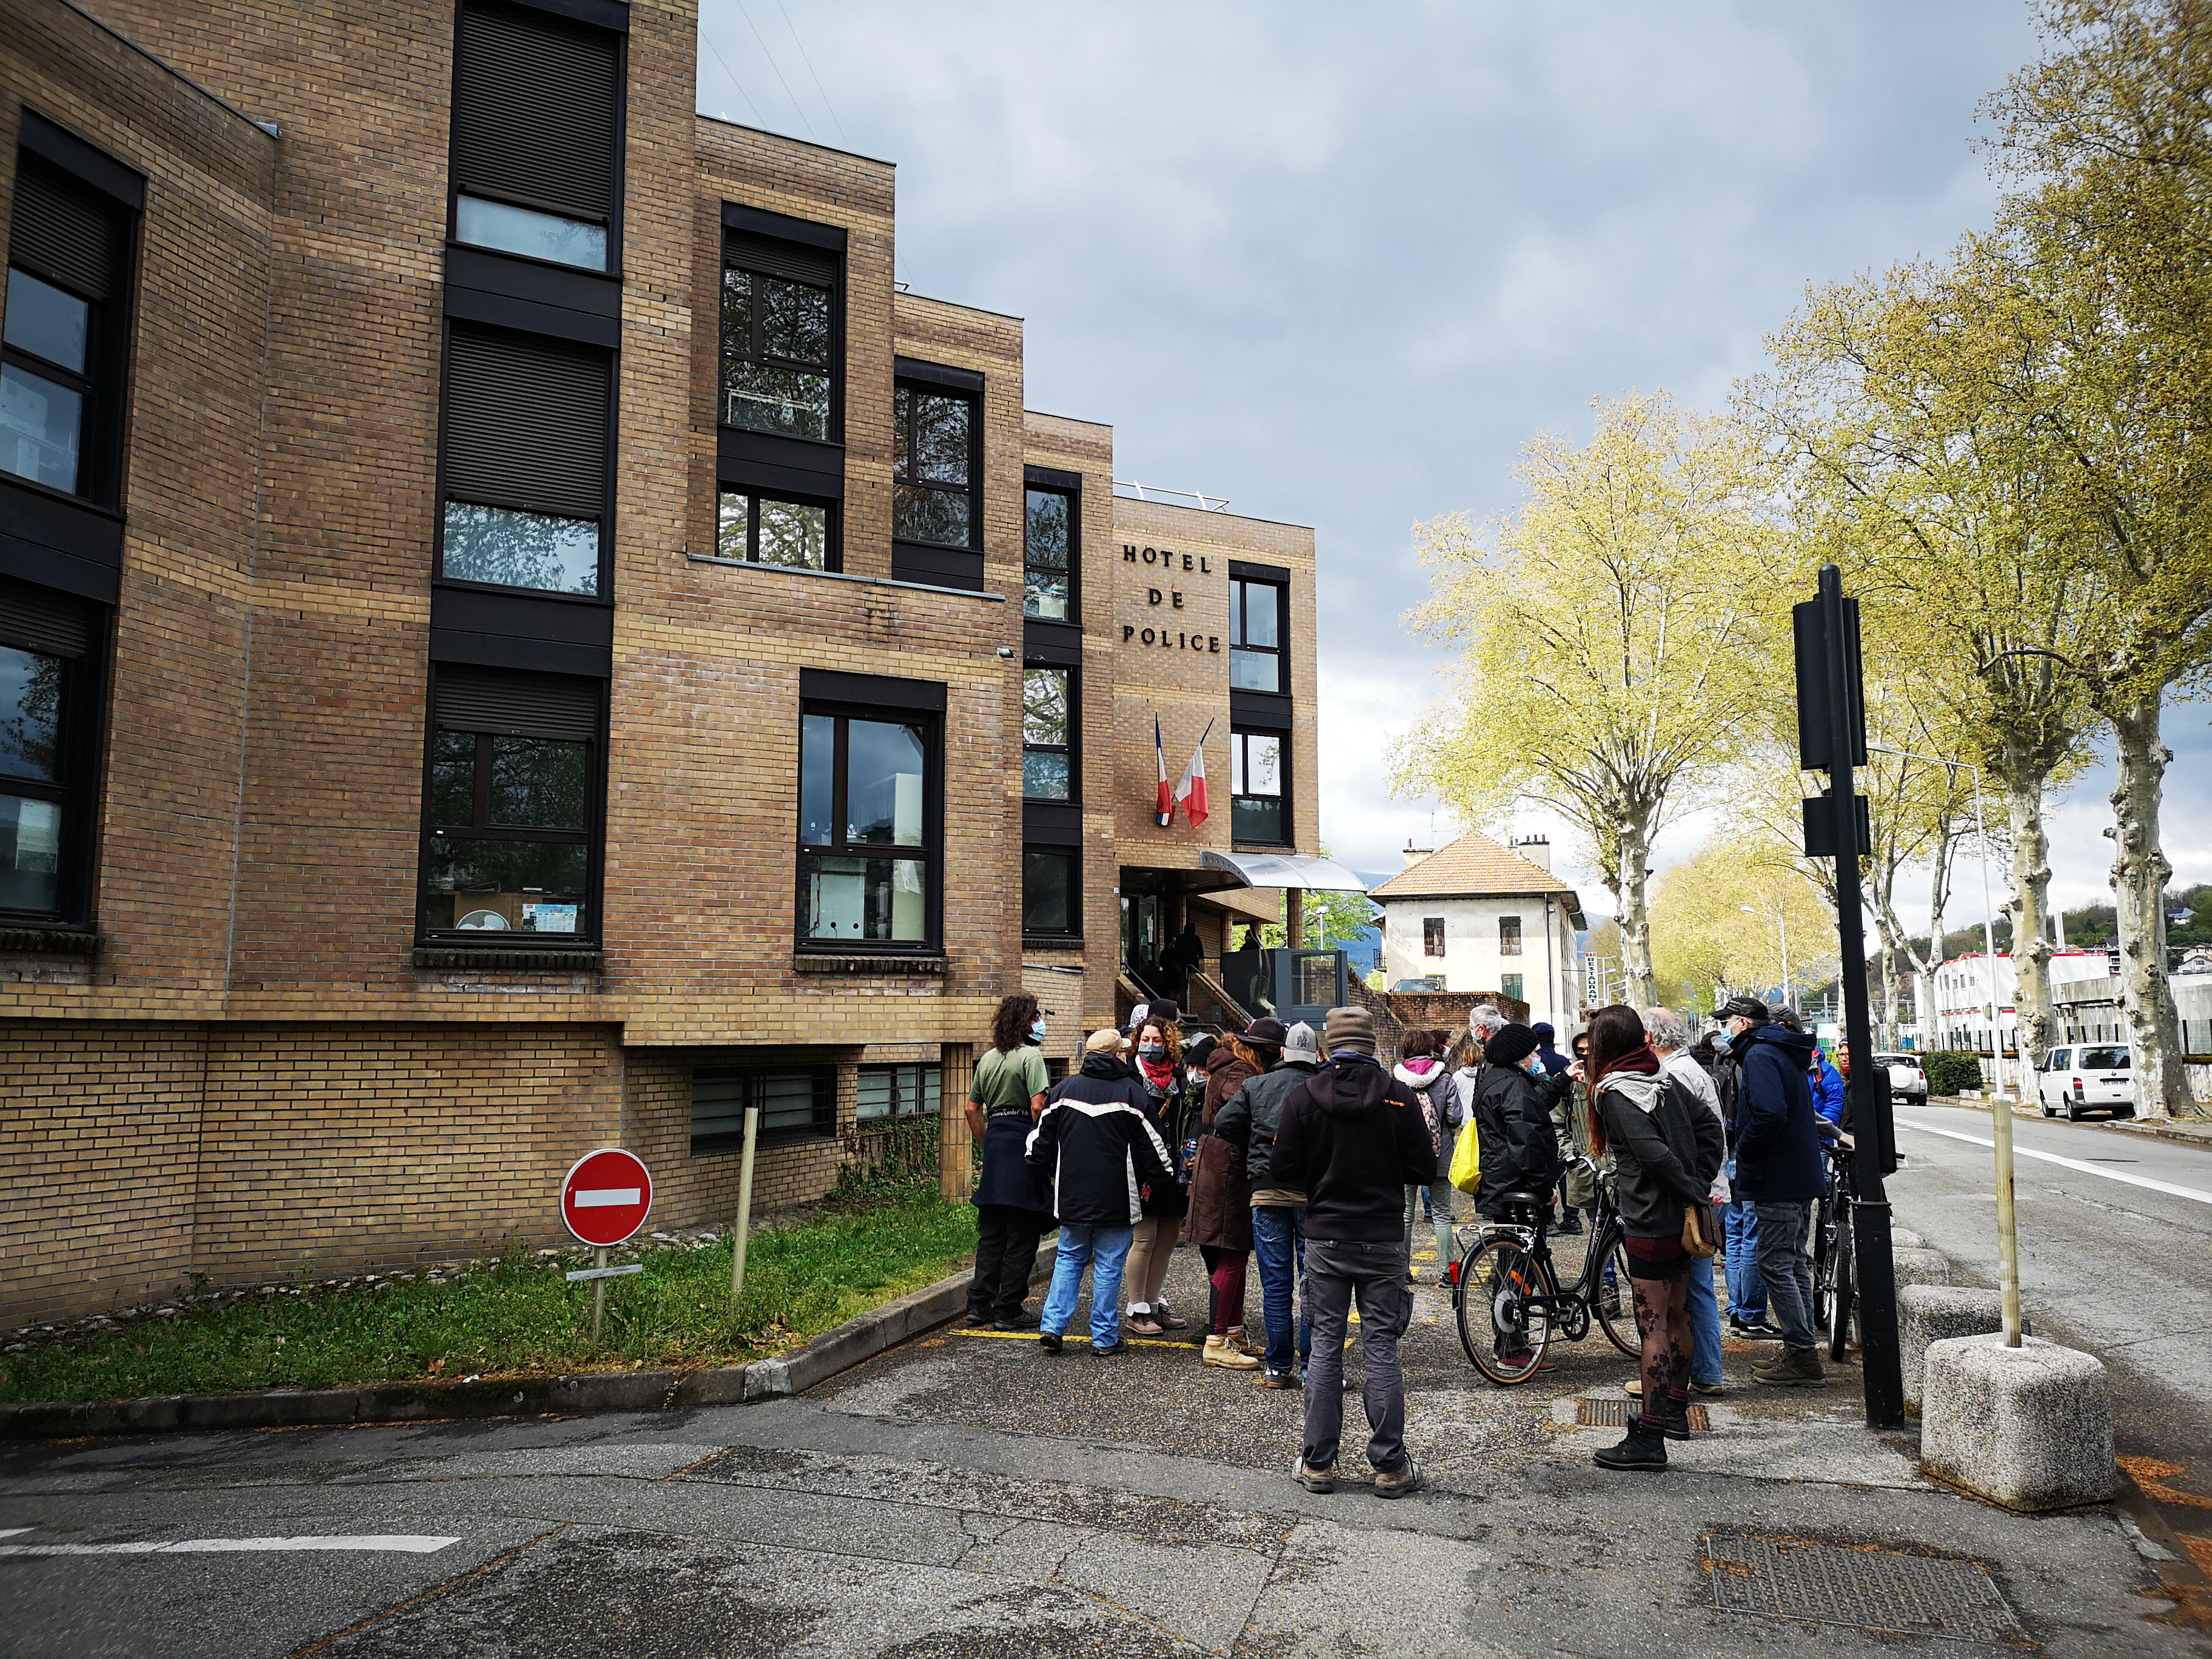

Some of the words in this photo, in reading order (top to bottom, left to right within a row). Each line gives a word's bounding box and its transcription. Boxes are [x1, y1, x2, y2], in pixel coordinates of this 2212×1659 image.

[1123, 545, 1212, 573] HOTEL
[1148, 588, 1184, 608] DE
[1123, 625, 1221, 653] POLICE
[1588, 958, 1597, 1003] RESTAURANT
